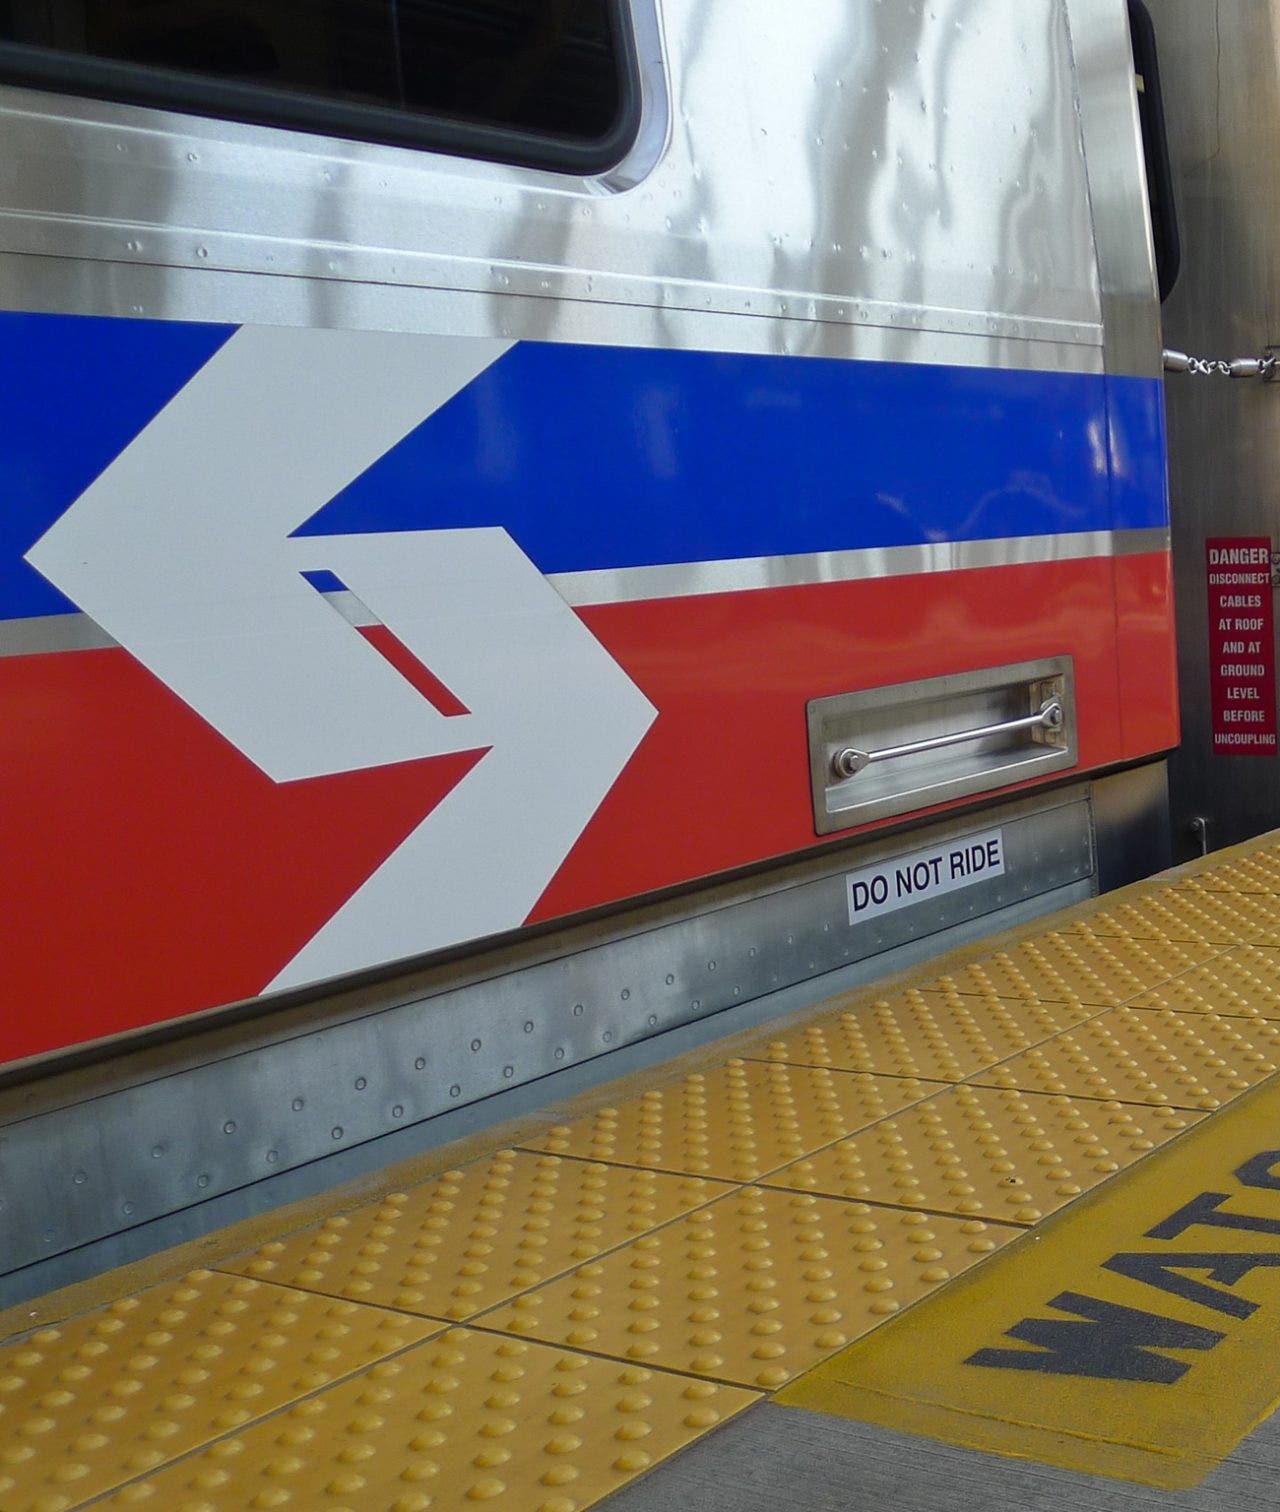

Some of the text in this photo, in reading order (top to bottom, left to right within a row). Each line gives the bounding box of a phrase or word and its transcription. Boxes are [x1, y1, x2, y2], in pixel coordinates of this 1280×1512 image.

[1209, 548, 1270, 565] DANGER
[1209, 572, 1271, 585] DISCONNECT
[1219, 595, 1262, 608] CABLES
[1218, 618, 1265, 631] AT ROOF
[1222, 641, 1261, 654] AND AT
[1220, 664, 1265, 677] GROUND
[1227, 687, 1260, 699] LEVEL
[1223, 710, 1265, 722] BEFORE
[1214, 733, 1276, 745] UNCOUPLING
[852, 839, 1000, 912] DO NOT RIDE
